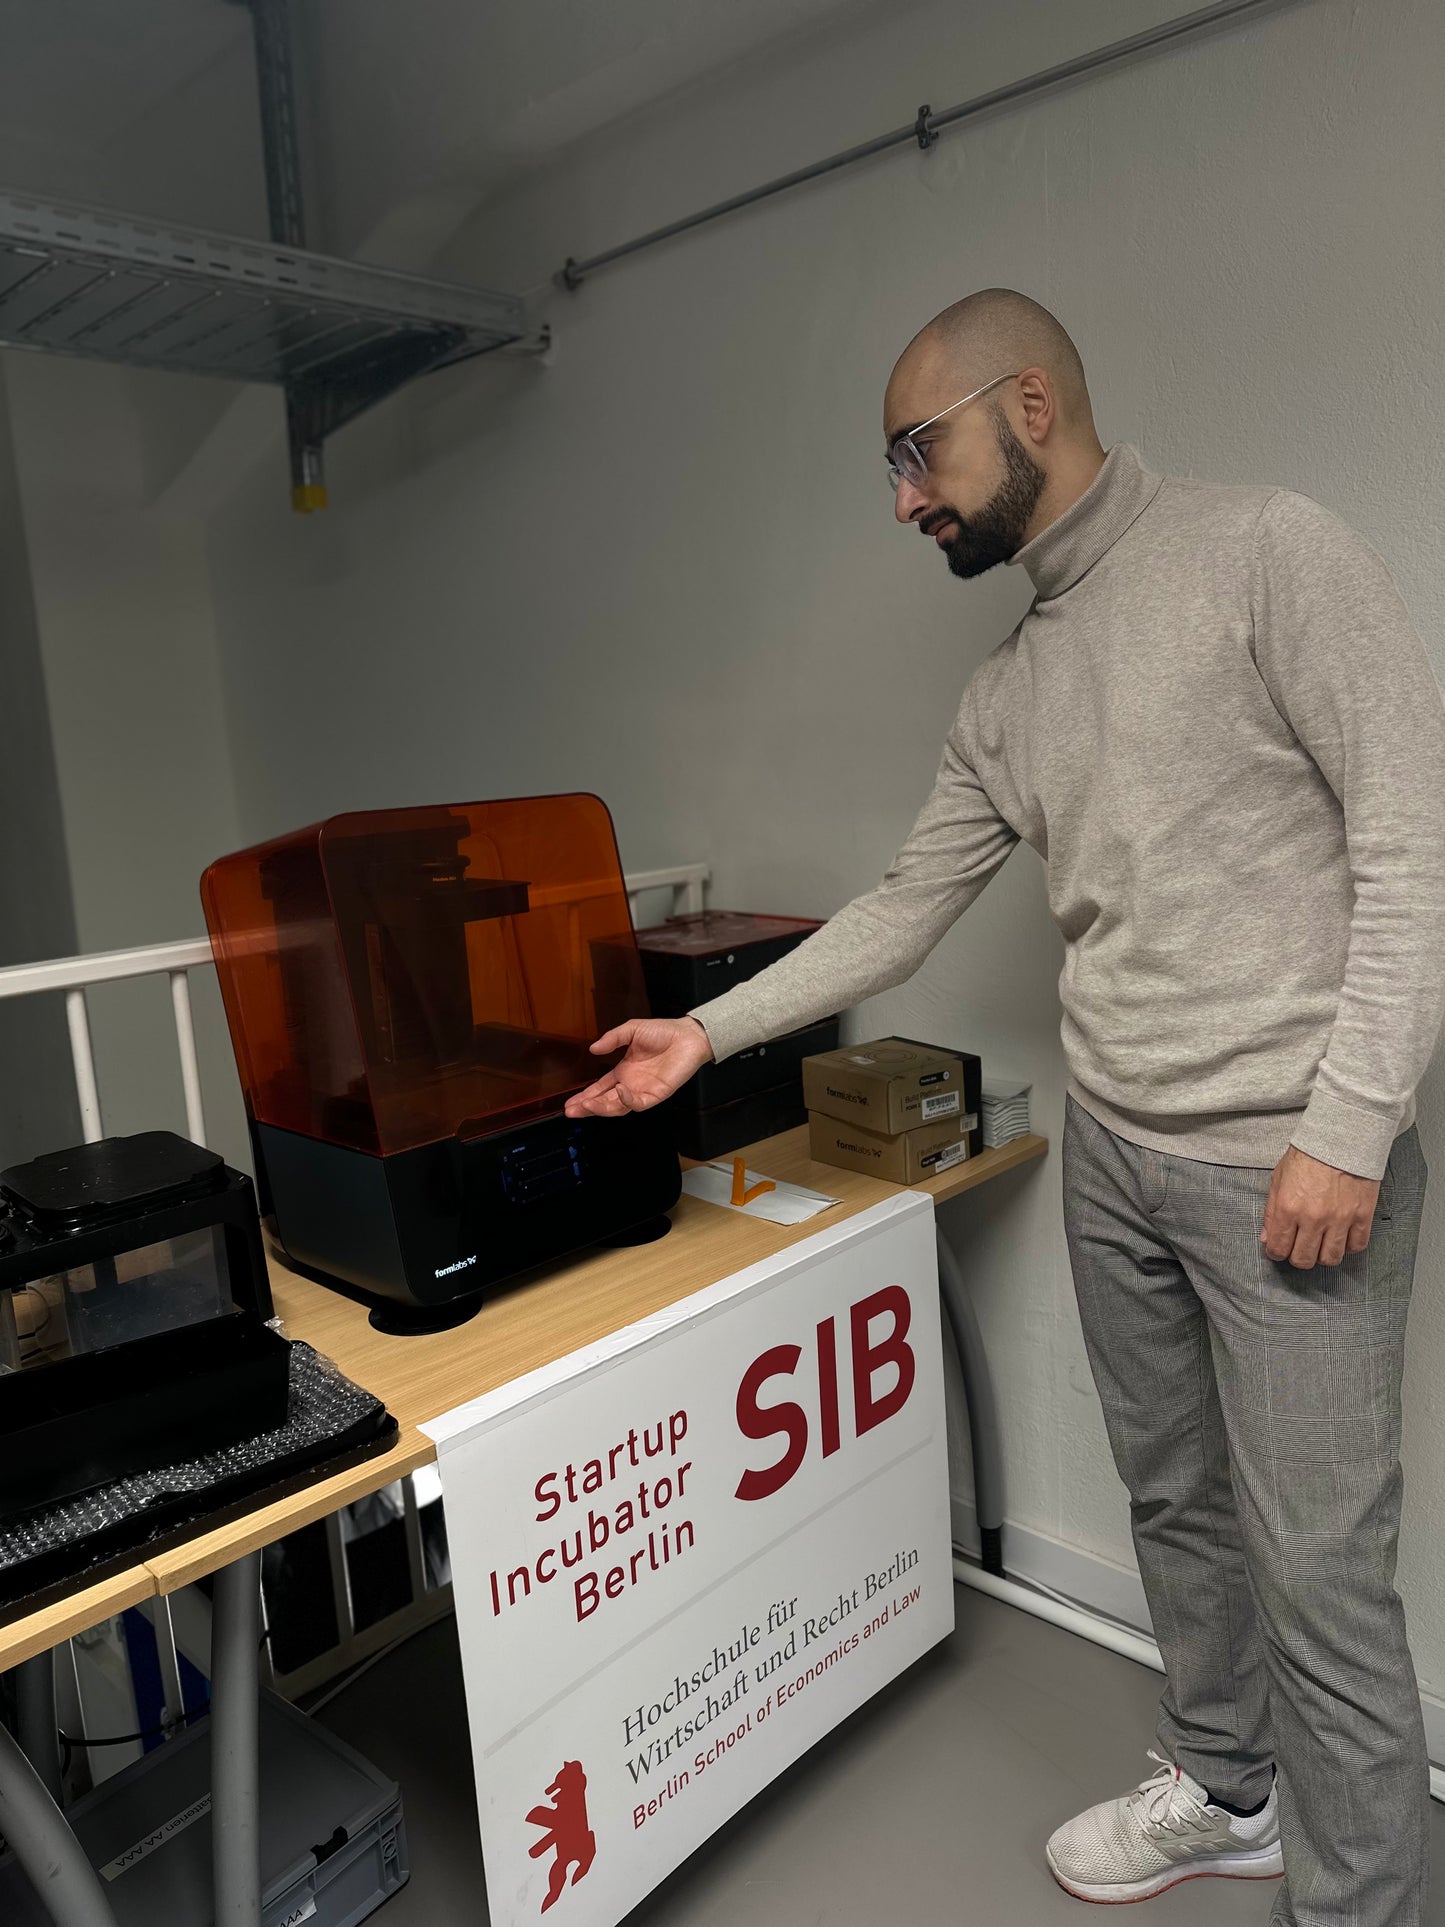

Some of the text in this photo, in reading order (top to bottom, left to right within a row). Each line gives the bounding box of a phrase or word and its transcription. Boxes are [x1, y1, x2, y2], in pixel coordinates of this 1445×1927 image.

[826, 1086, 858, 1104] formlabs
[836, 1139, 871, 1157] formlabs
[434, 1258, 468, 1279] formlabs
[733, 1284, 916, 1502] SIB
[534, 1409, 688, 1522] Startup
[489, 1461, 692, 1617] Incubator
[574, 1520, 695, 1623] Berlin
[622, 1596, 798, 1748] Hochschule für
[625, 1548, 920, 1785] Wirtschaft und Recht Berlin
[632, 1584, 921, 1830] Berlin School of Economics and Law
[115, 1846, 143, 1867] AAA
[144, 1830, 163, 1846] AA
